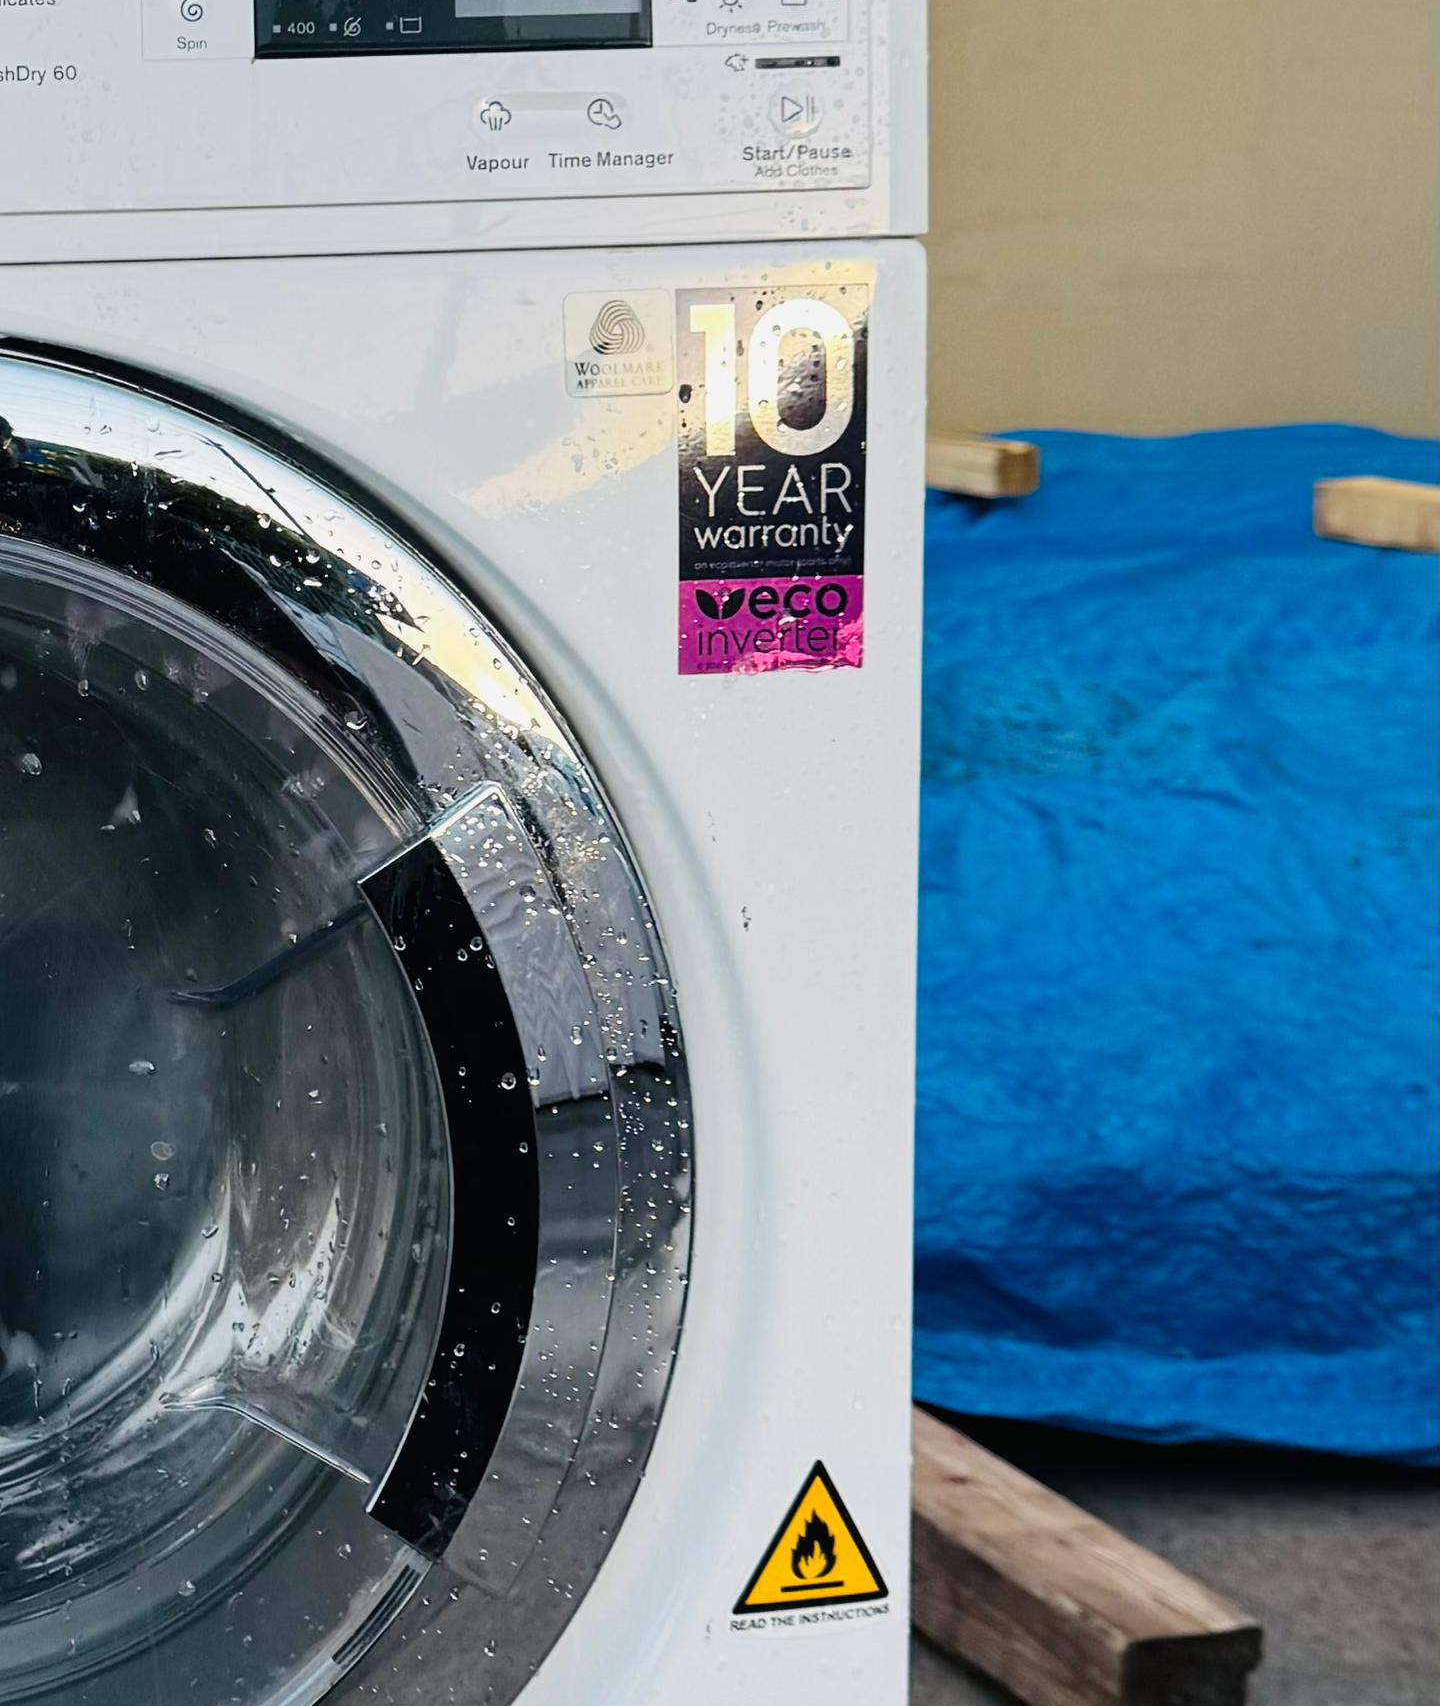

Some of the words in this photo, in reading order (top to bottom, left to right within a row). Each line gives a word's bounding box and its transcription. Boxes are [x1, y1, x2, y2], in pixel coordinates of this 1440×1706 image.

[287, 21, 315, 35] 400
[706, 23, 760, 37] Dryness
[768, 20, 825, 33] Prewash
[177, 36, 208, 50] Spin
[53, 66, 77, 81] 60
[742, 144, 852, 162] Start/Pause
[467, 155, 529, 173] Vapour
[548, 153, 591, 169] Time
[597, 151, 674, 170] Manager
[754, 164, 782, 178] Add
[786, 164, 838, 177] Clothes
[574, 361, 664, 376] WOOLMARK
[690, 298, 855, 457] 10
[693, 462, 852, 518] YEAR
[693, 520, 854, 553] warranty
[748, 583, 848, 620] eco
[730, 1618, 766, 1632] READ
[771, 1615, 795, 1627] THE
[799, 1603, 890, 1624] INSTRUCTIONS
